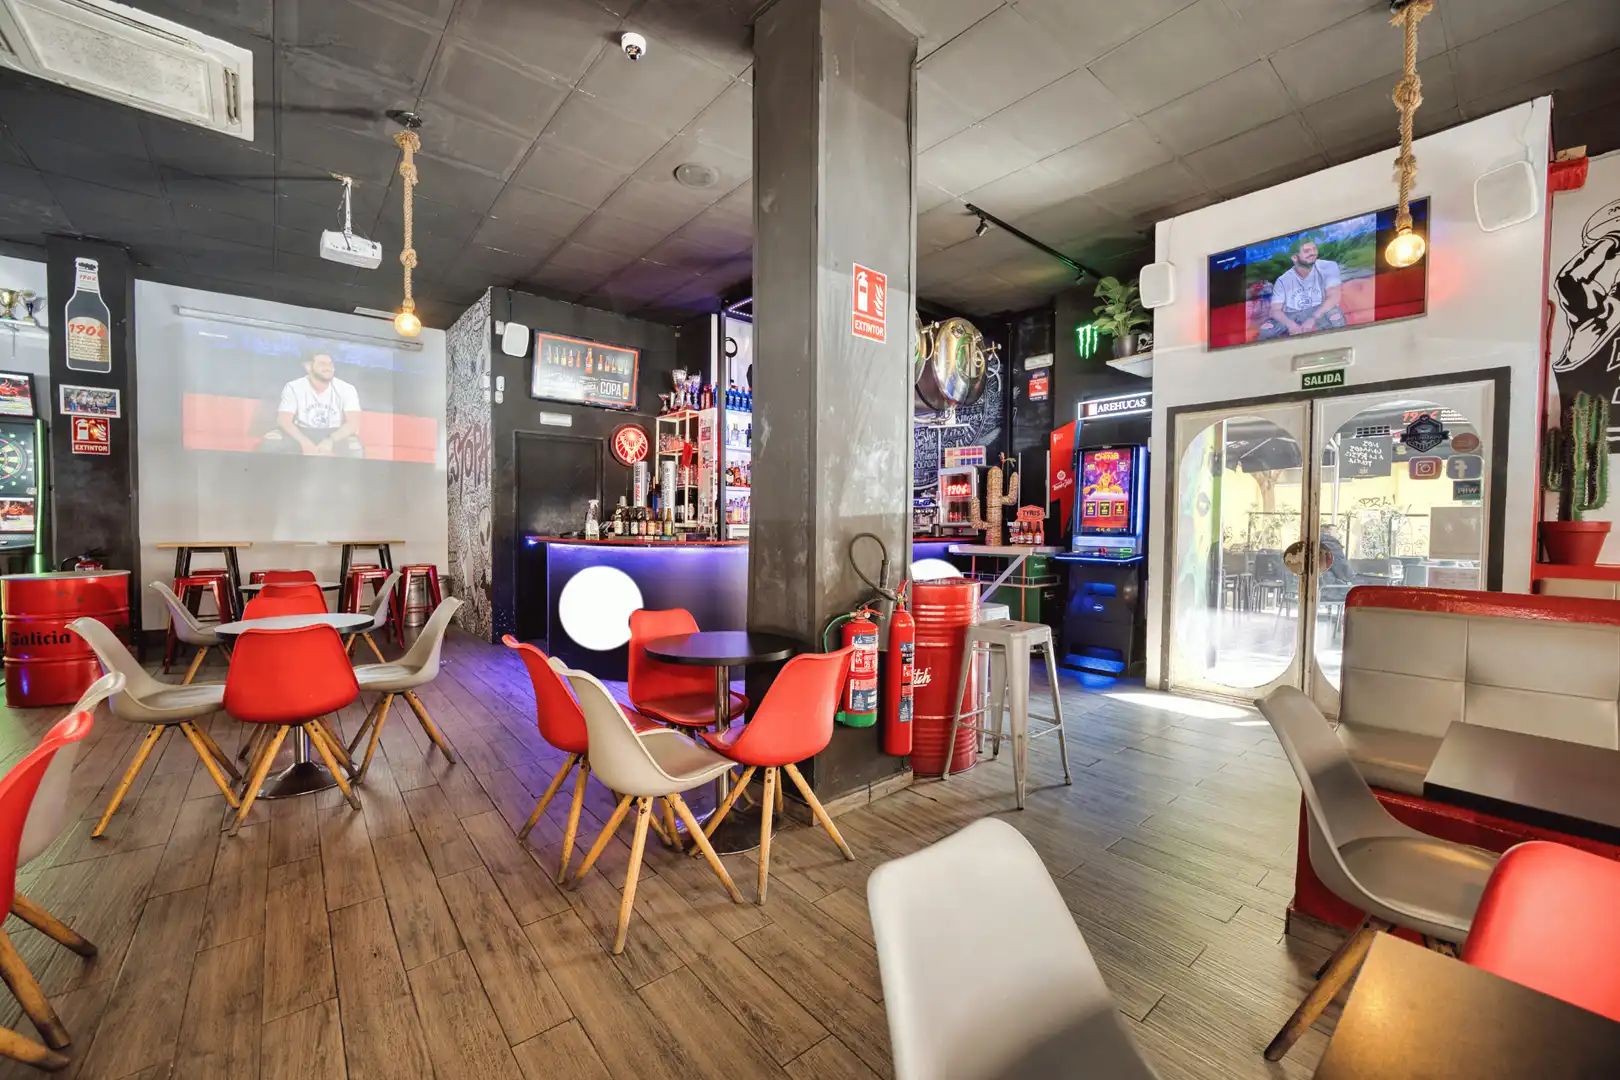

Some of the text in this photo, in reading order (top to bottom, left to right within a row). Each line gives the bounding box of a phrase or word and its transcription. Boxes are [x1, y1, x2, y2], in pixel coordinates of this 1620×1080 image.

[69, 323, 105, 337] 1906
[855, 319, 884, 337] EXTINTOR
[1303, 372, 1342, 387] SALIDA
[600, 381, 622, 397] COPA
[1097, 397, 1147, 413] AREHUCAS
[75, 444, 108, 452] EXTINTOR
[947, 484, 968, 496] 1906
[1022, 509, 1041, 517] TYRIS
